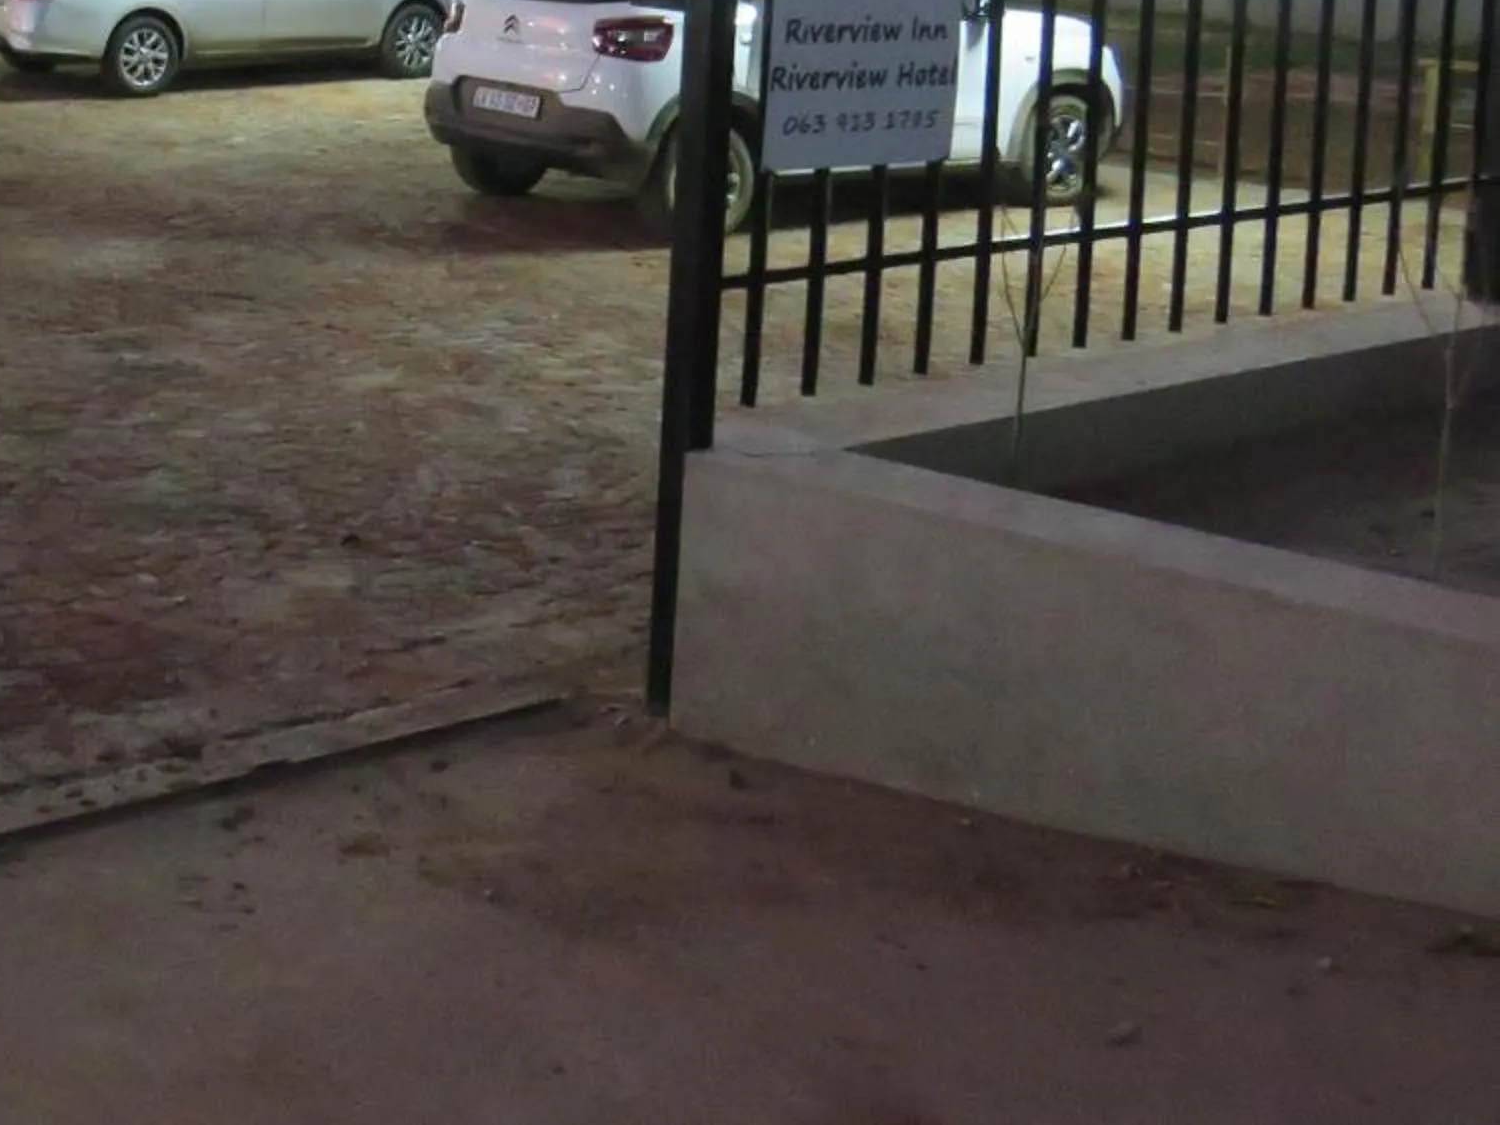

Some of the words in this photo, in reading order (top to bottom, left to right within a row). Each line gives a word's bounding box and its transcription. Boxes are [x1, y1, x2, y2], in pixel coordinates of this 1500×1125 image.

[785, 15, 902, 44] Riverview
[911, 15, 949, 42] Inn
[769, 60, 889, 92] Riverview
[896, 55, 958, 88] Hotel
[782, 111, 827, 136] 063
